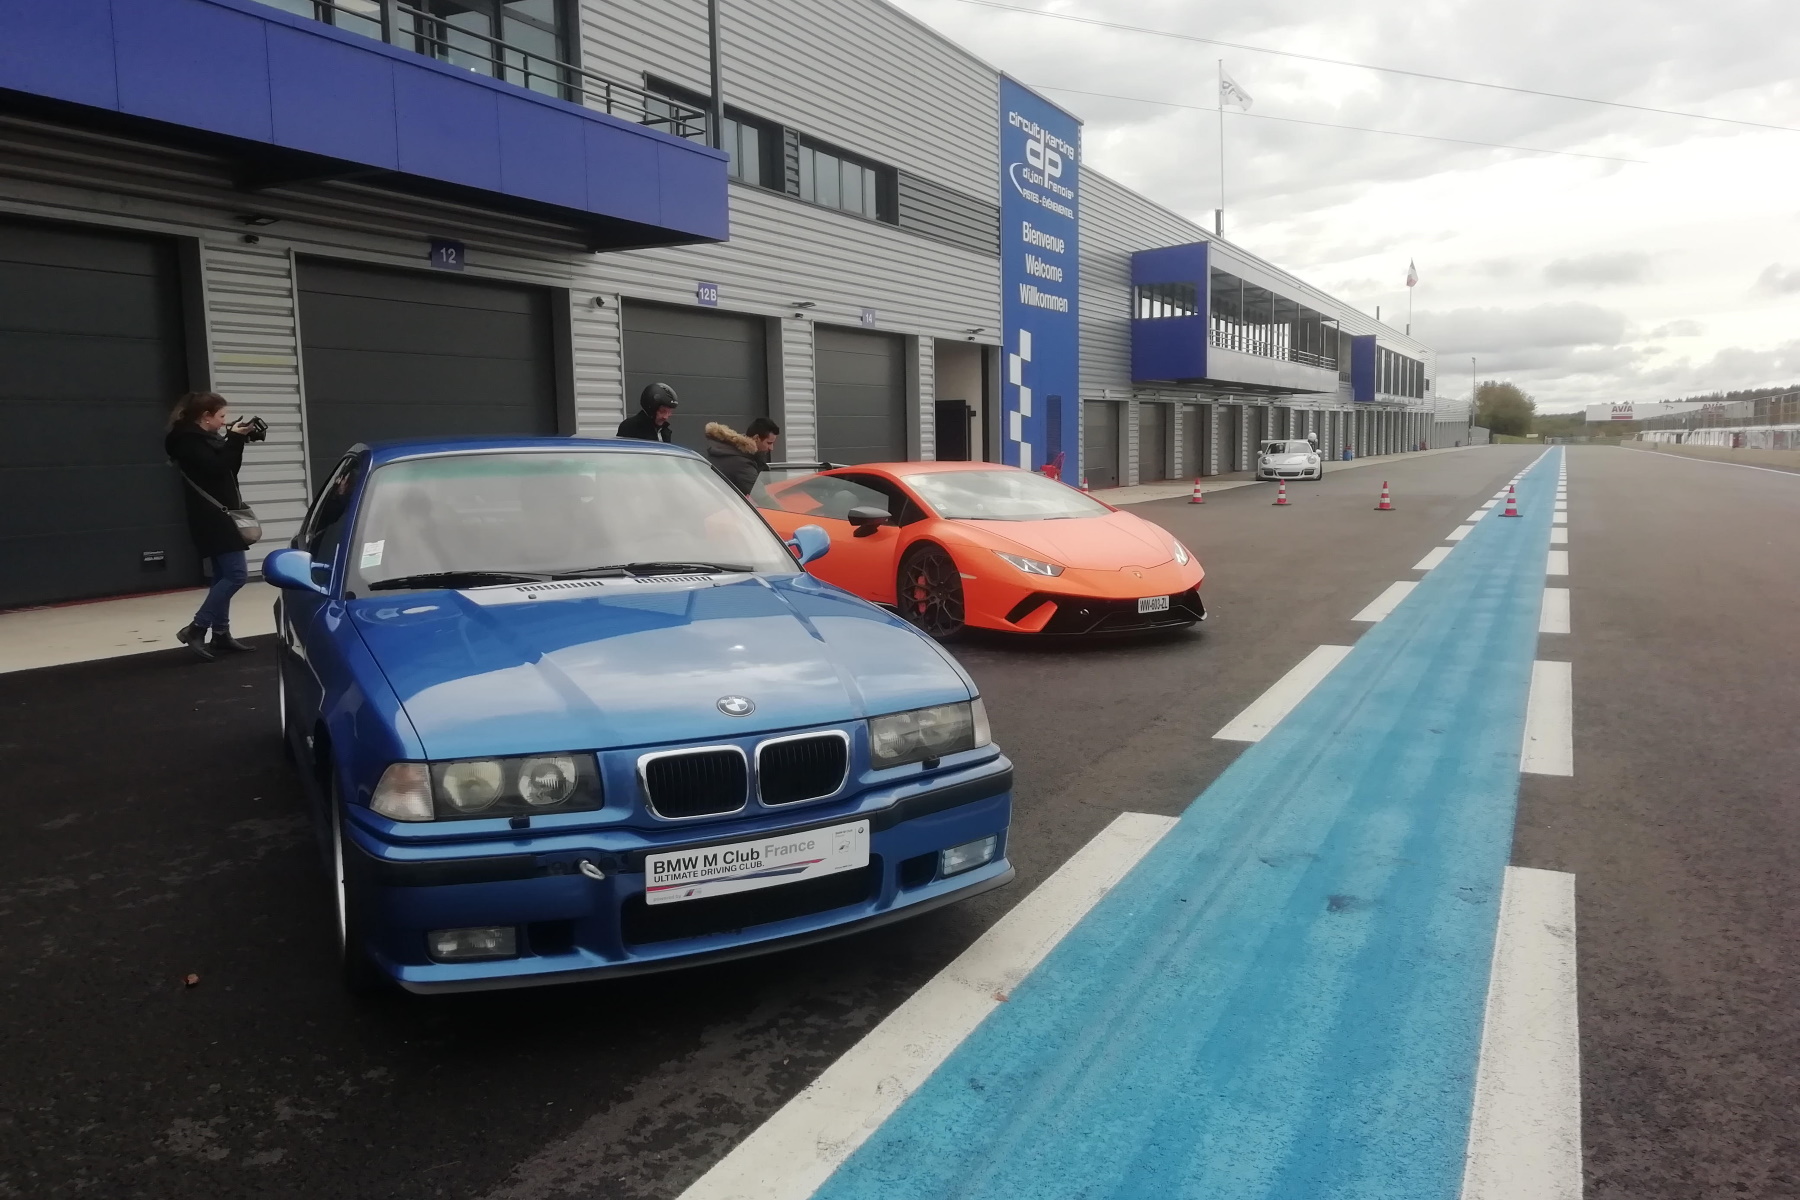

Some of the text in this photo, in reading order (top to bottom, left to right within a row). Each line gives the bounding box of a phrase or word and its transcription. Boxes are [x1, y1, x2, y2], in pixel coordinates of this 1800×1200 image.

[1009, 111, 1075, 160] circuit karting
[1022, 167, 1043, 186] dijon
[1022, 220, 1065, 254] Bienvenue
[440, 247, 456, 264] 12
[1025, 253, 1063, 283] Welcome
[1019, 283, 1068, 313] Willkommen
[865, 312, 873, 323] 14
[1611, 405, 1633, 413] AVIA
[653, 840, 816, 875] BMW M Club France
[654, 859, 765, 883] ULTIMATE DRIVING CLUB.
